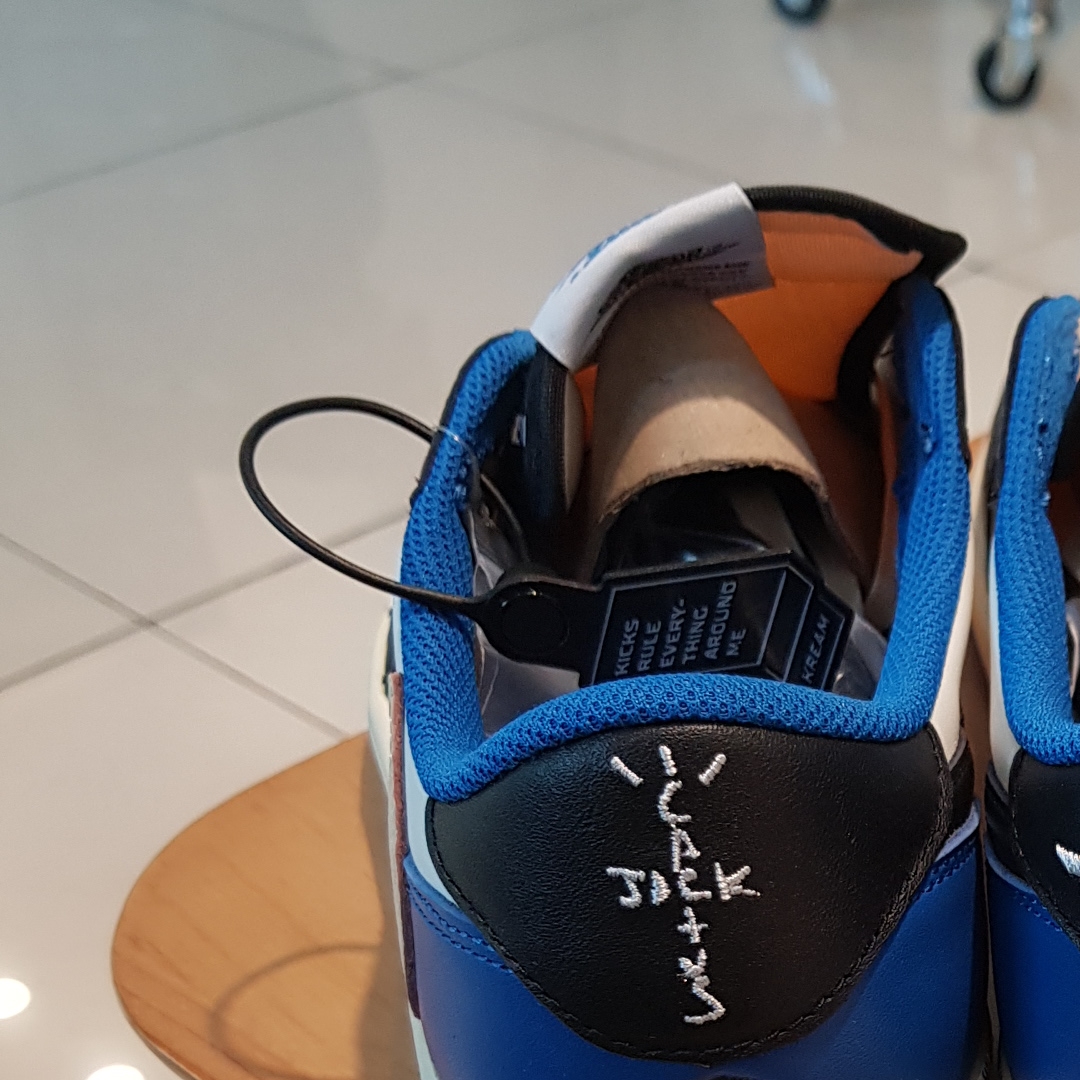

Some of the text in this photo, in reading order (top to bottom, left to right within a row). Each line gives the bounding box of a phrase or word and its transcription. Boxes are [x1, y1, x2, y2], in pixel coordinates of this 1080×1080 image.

[614, 617, 640, 676] KICKS
[637, 620, 662, 672] RULE
[681, 605, 709, 666] THING
[703, 579, 737, 660] AROUND
[726, 628, 747, 656] ME
[801, 613, 830, 684] KREAM
